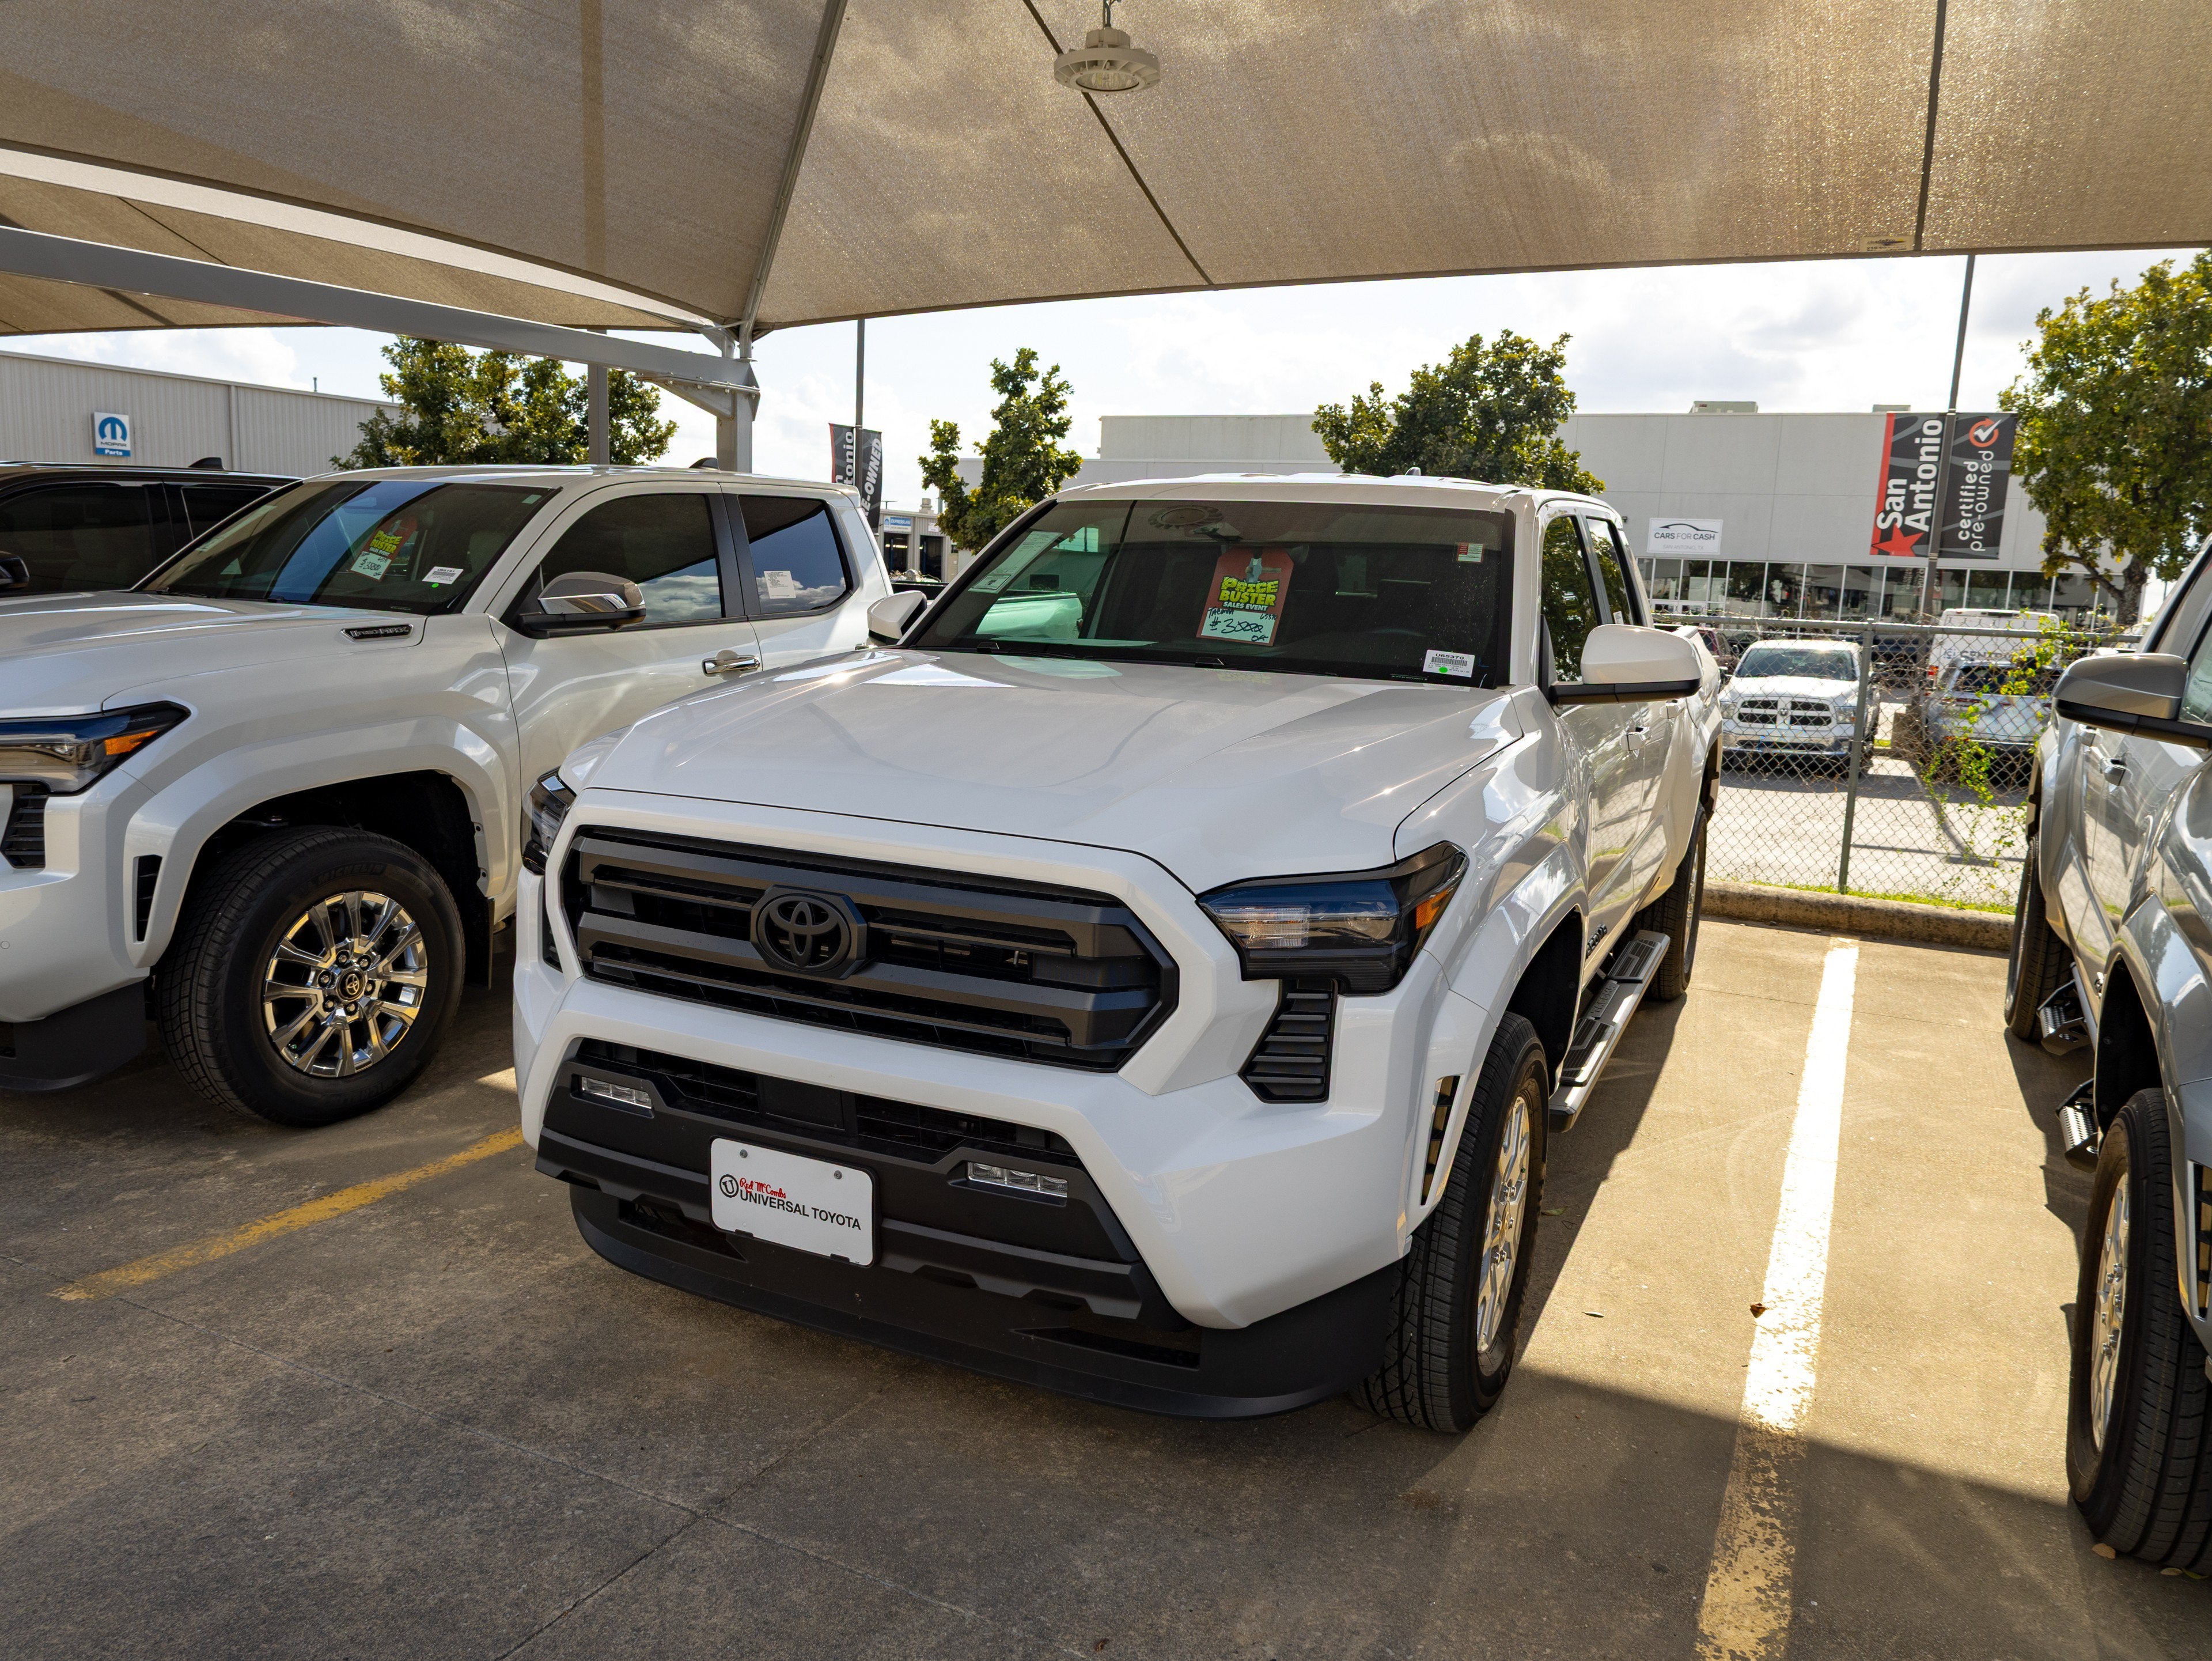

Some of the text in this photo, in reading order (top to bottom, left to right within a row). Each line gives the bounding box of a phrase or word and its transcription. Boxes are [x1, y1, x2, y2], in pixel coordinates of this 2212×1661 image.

[843, 431, 854, 485] tonio
[1904, 419, 1943, 532] Antonio
[1876, 479, 1908, 529] San
[1958, 461, 1979, 540] certified
[1970, 451, 1994, 551] pre-owned
[370, 539, 397, 553] BUSTER
[374, 530, 403, 544] PRICE
[1219, 590, 1276, 606] BUSTER
[1221, 576, 1279, 593] PRICE
[1222, 601, 1244, 609] SALES
[740, 1178, 786, 1199] Red McCombs
[740, 1189, 861, 1230] UNIVERSAL TOYOTA
